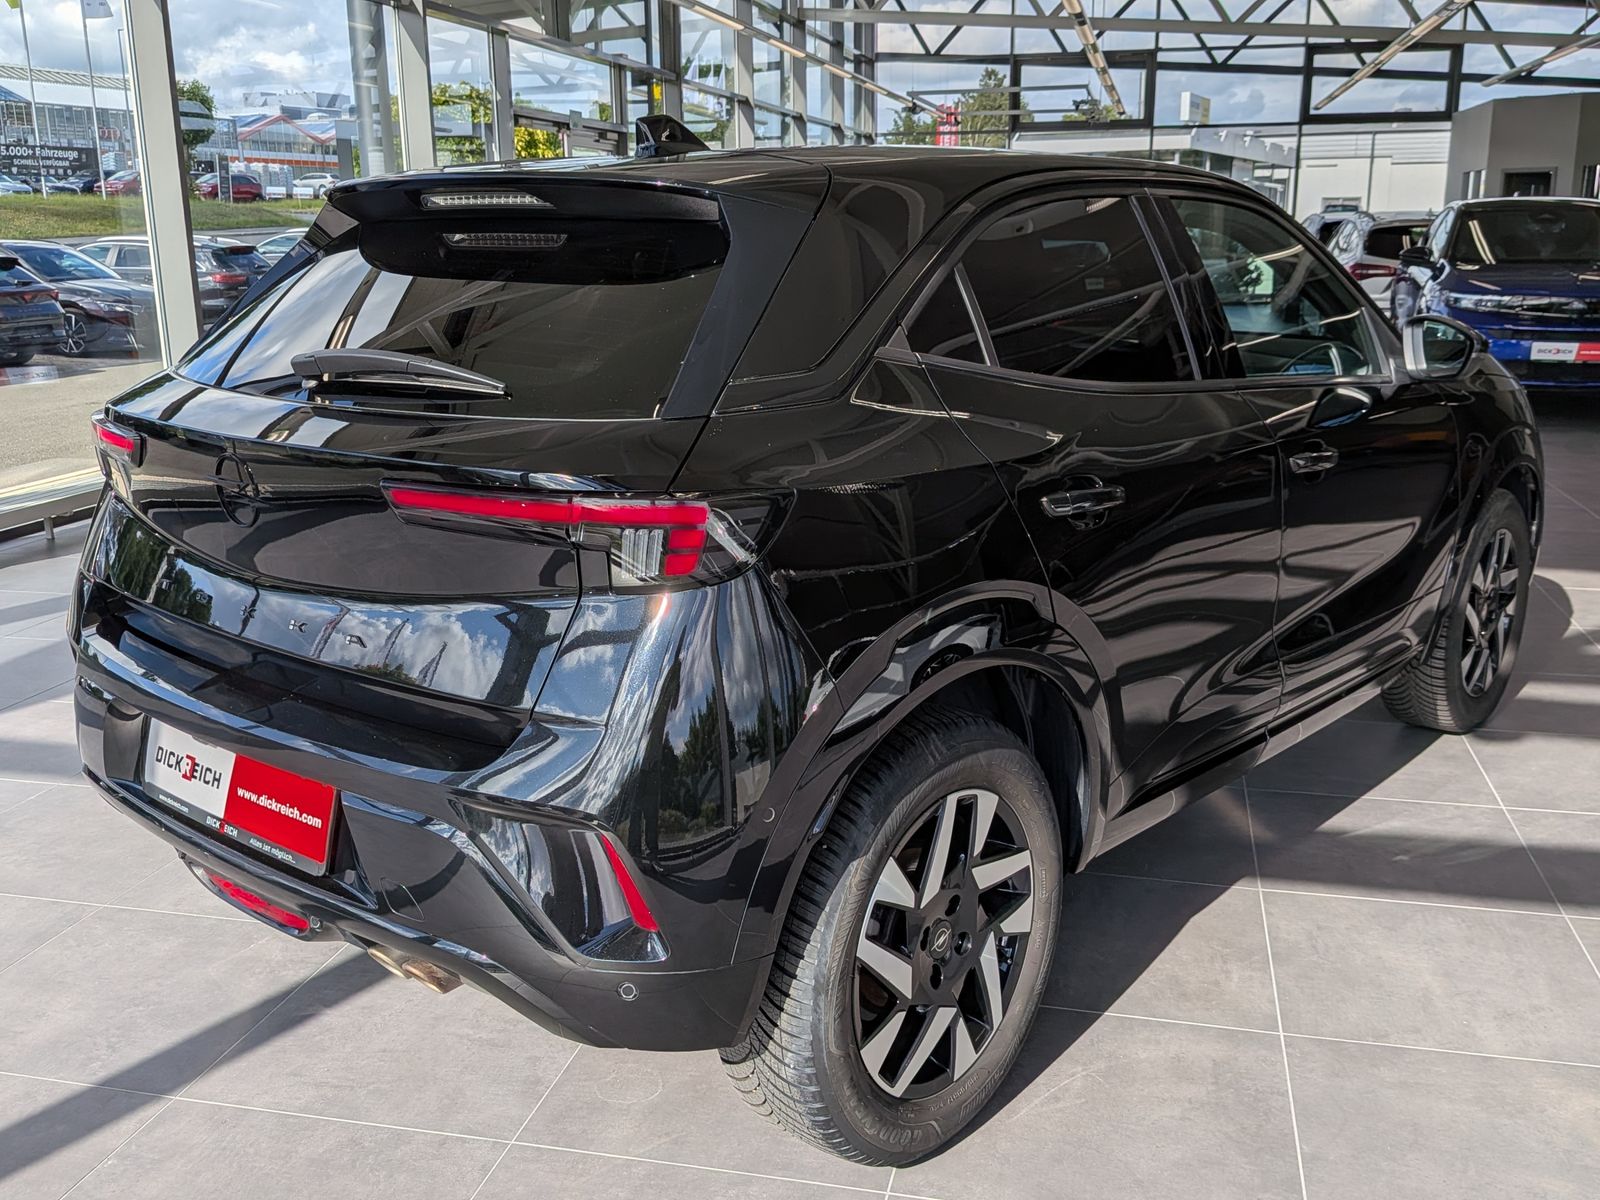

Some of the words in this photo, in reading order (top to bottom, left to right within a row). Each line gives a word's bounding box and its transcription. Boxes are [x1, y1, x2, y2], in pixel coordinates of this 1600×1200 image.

[0, 145, 33, 156] 5.000+
[35, 147, 79, 160] Fahrzeuge
[13, 158, 39, 166] SCHNELL
[237, 786, 322, 829] www.dickreich.com
[249, 837, 263, 849] Alles
